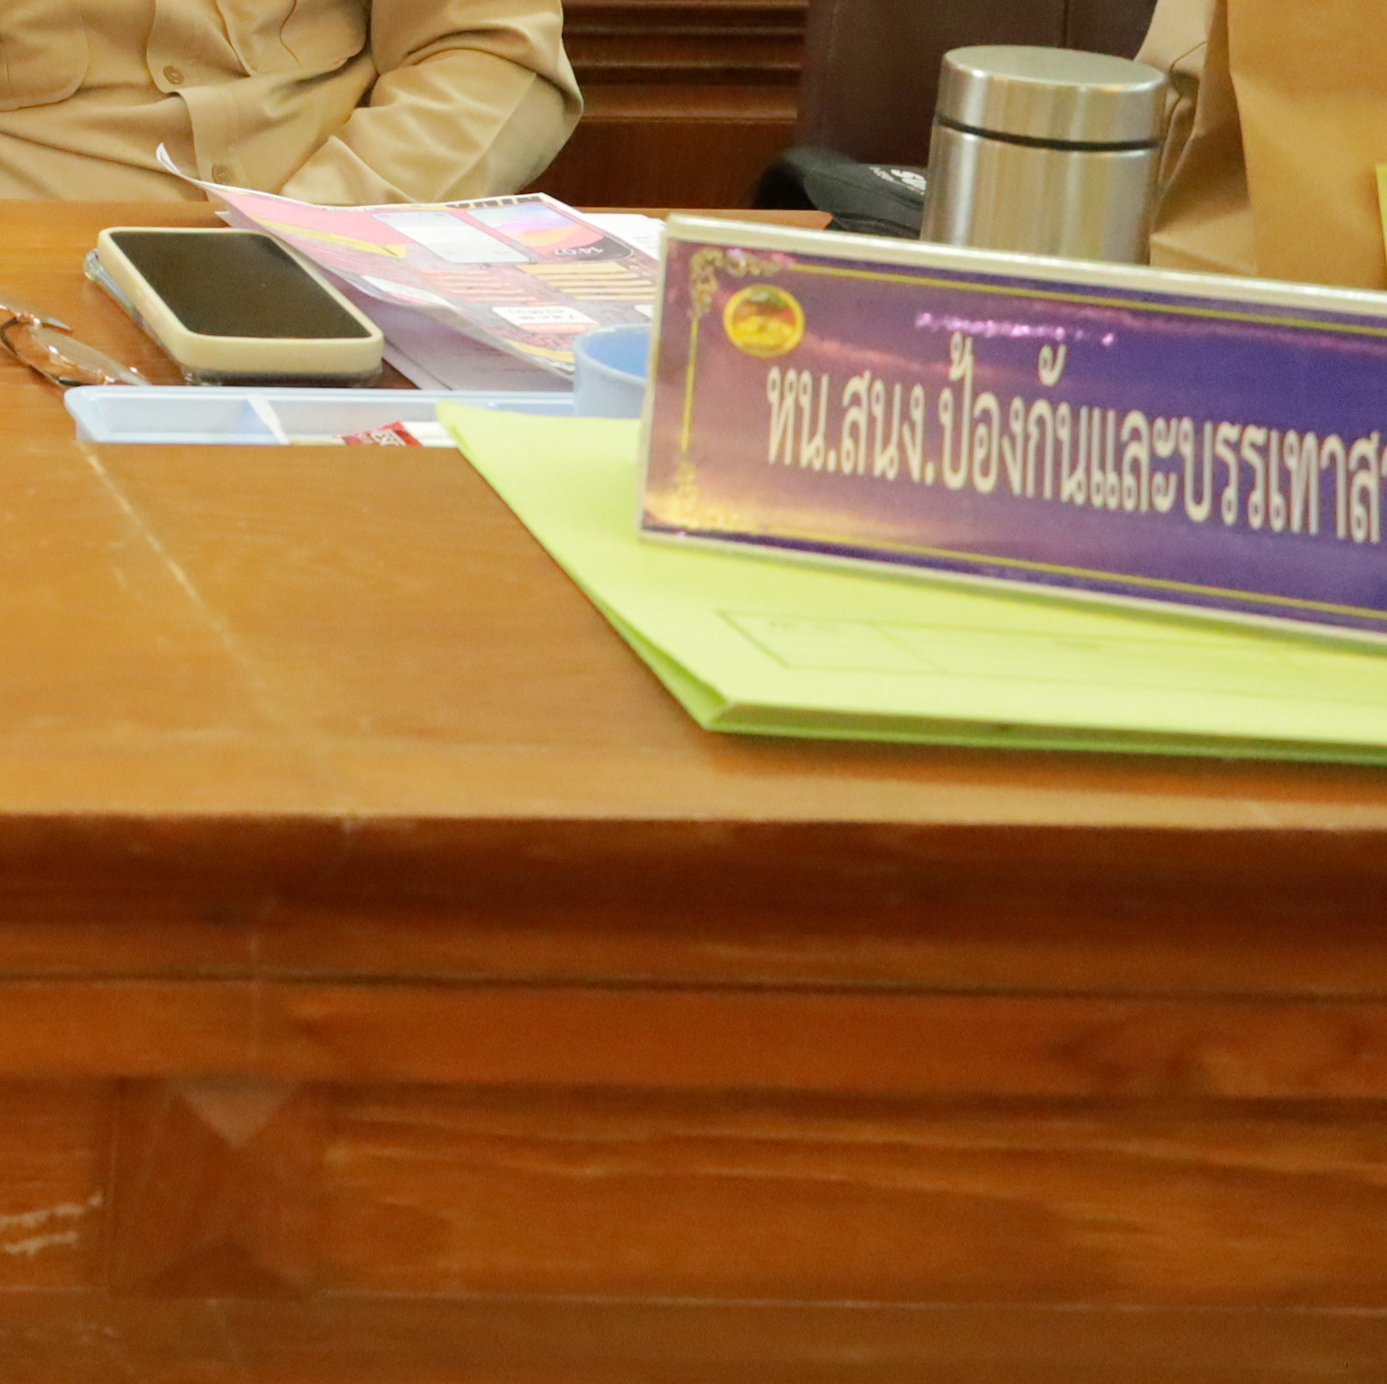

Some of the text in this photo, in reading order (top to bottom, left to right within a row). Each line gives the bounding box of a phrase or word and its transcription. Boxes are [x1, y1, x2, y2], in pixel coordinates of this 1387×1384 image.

[766, 331, 1387, 545] หน.สนง.ป้องกันและบรรเทาส
